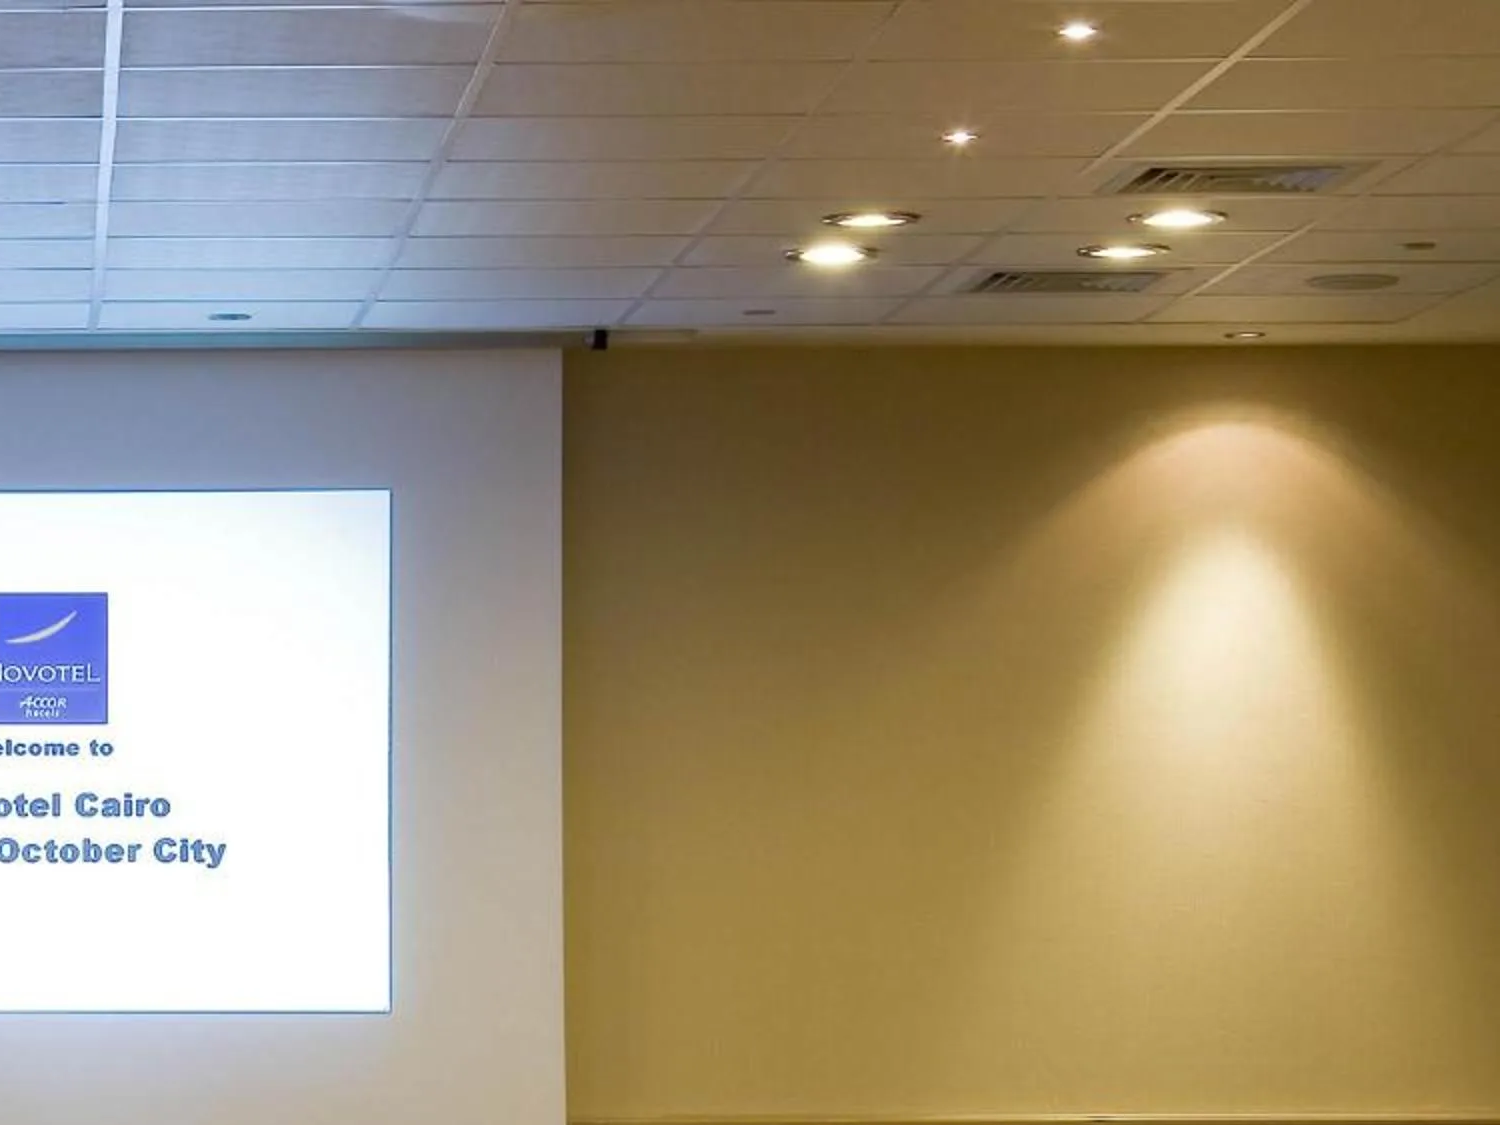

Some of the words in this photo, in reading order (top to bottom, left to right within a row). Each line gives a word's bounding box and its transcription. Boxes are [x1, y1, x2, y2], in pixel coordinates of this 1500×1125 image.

[89, 738, 114, 757] to
[74, 791, 172, 818] Cairo
[152, 836, 227, 869] City
